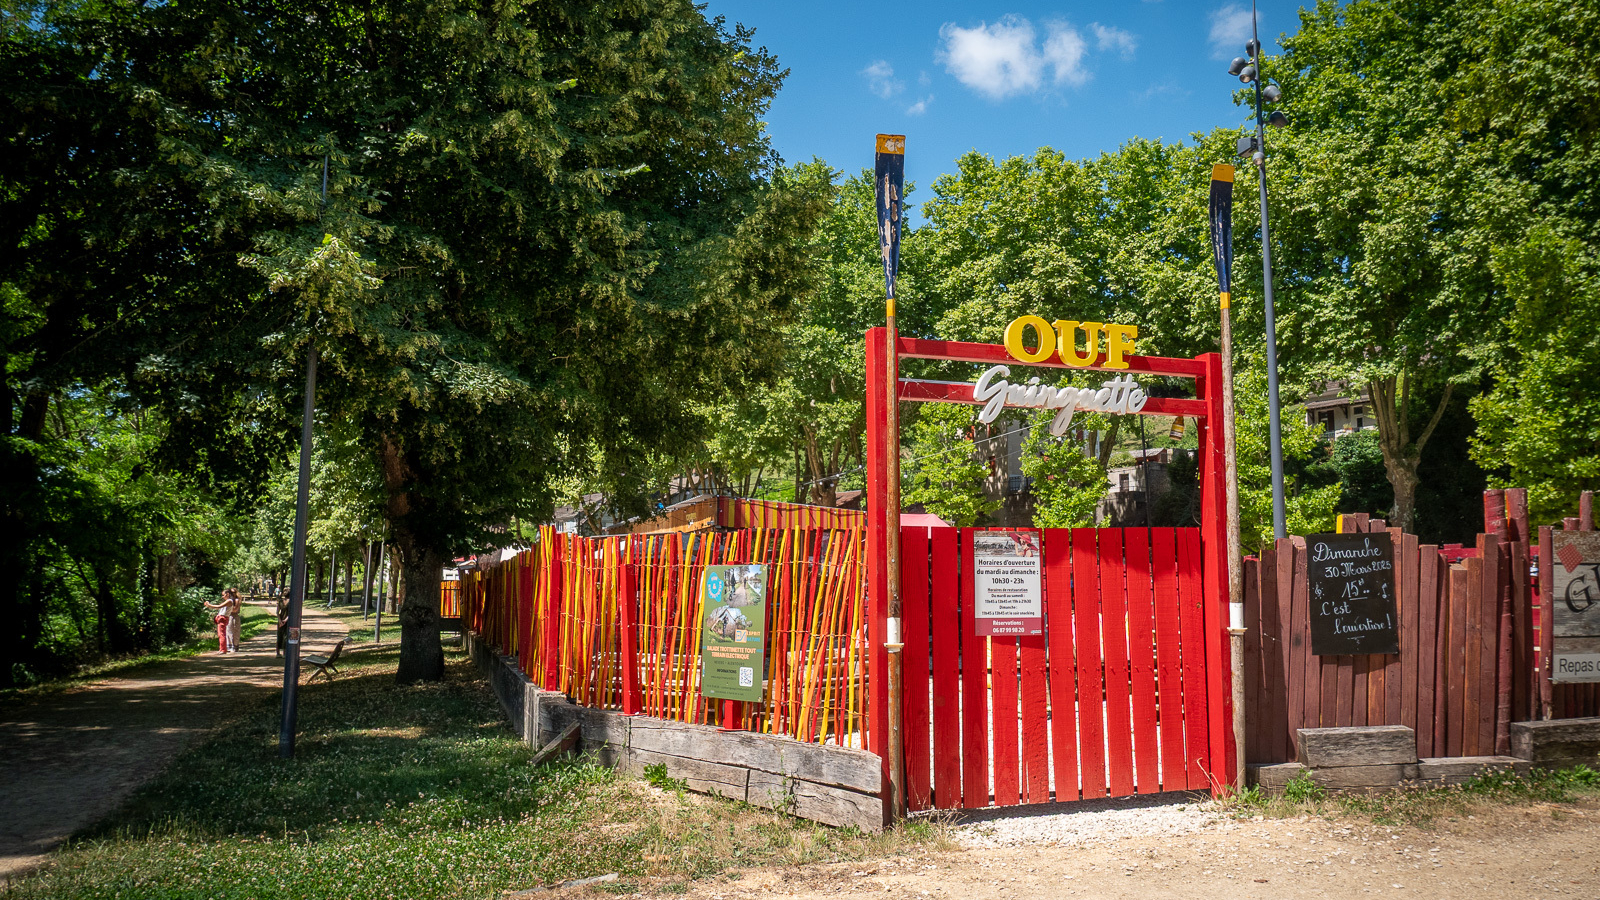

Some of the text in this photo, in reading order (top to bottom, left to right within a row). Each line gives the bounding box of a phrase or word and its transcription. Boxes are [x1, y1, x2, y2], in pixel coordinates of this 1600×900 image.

[1003, 315, 1138, 369] OUF
[973, 365, 1148, 436] Guinguette
[1312, 537, 1382, 562] Dimanche
[1324, 560, 1392, 578] 30 Mars 2025
[1320, 601, 1352, 616] C'est
[1559, 658, 1594, 675] Repas
